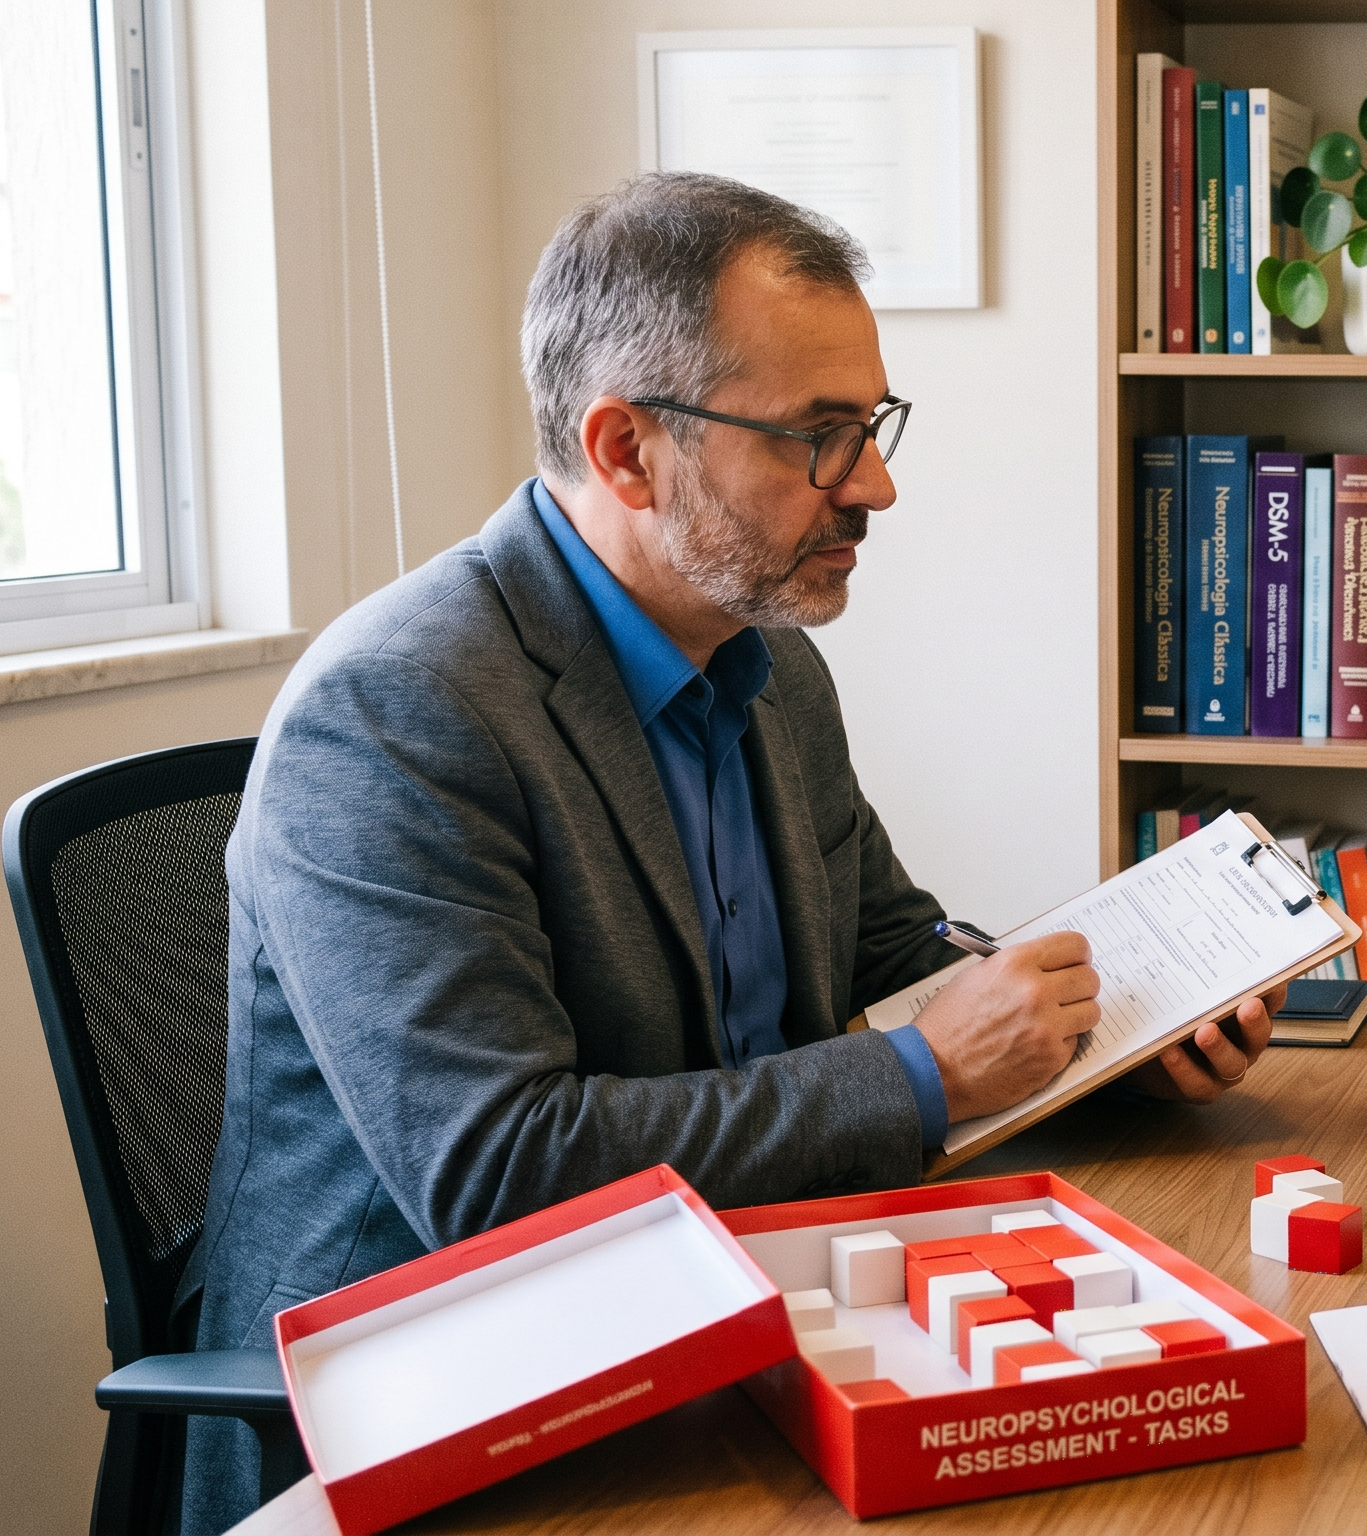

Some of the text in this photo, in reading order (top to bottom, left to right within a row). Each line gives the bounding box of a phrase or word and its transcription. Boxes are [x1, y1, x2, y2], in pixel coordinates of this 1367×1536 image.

[1155, 487, 1173, 616] Neuropsicologia
[1211, 486, 1230, 616] Neuropsicologia
[1268, 492, 1289, 562] DSM-5
[920, 1378, 1245, 1450] NEUROPSYCHOLOGICAL
[934, 1427, 1121, 1481] ASSESSMENT
[1144, 1411, 1230, 1446] TASKS
